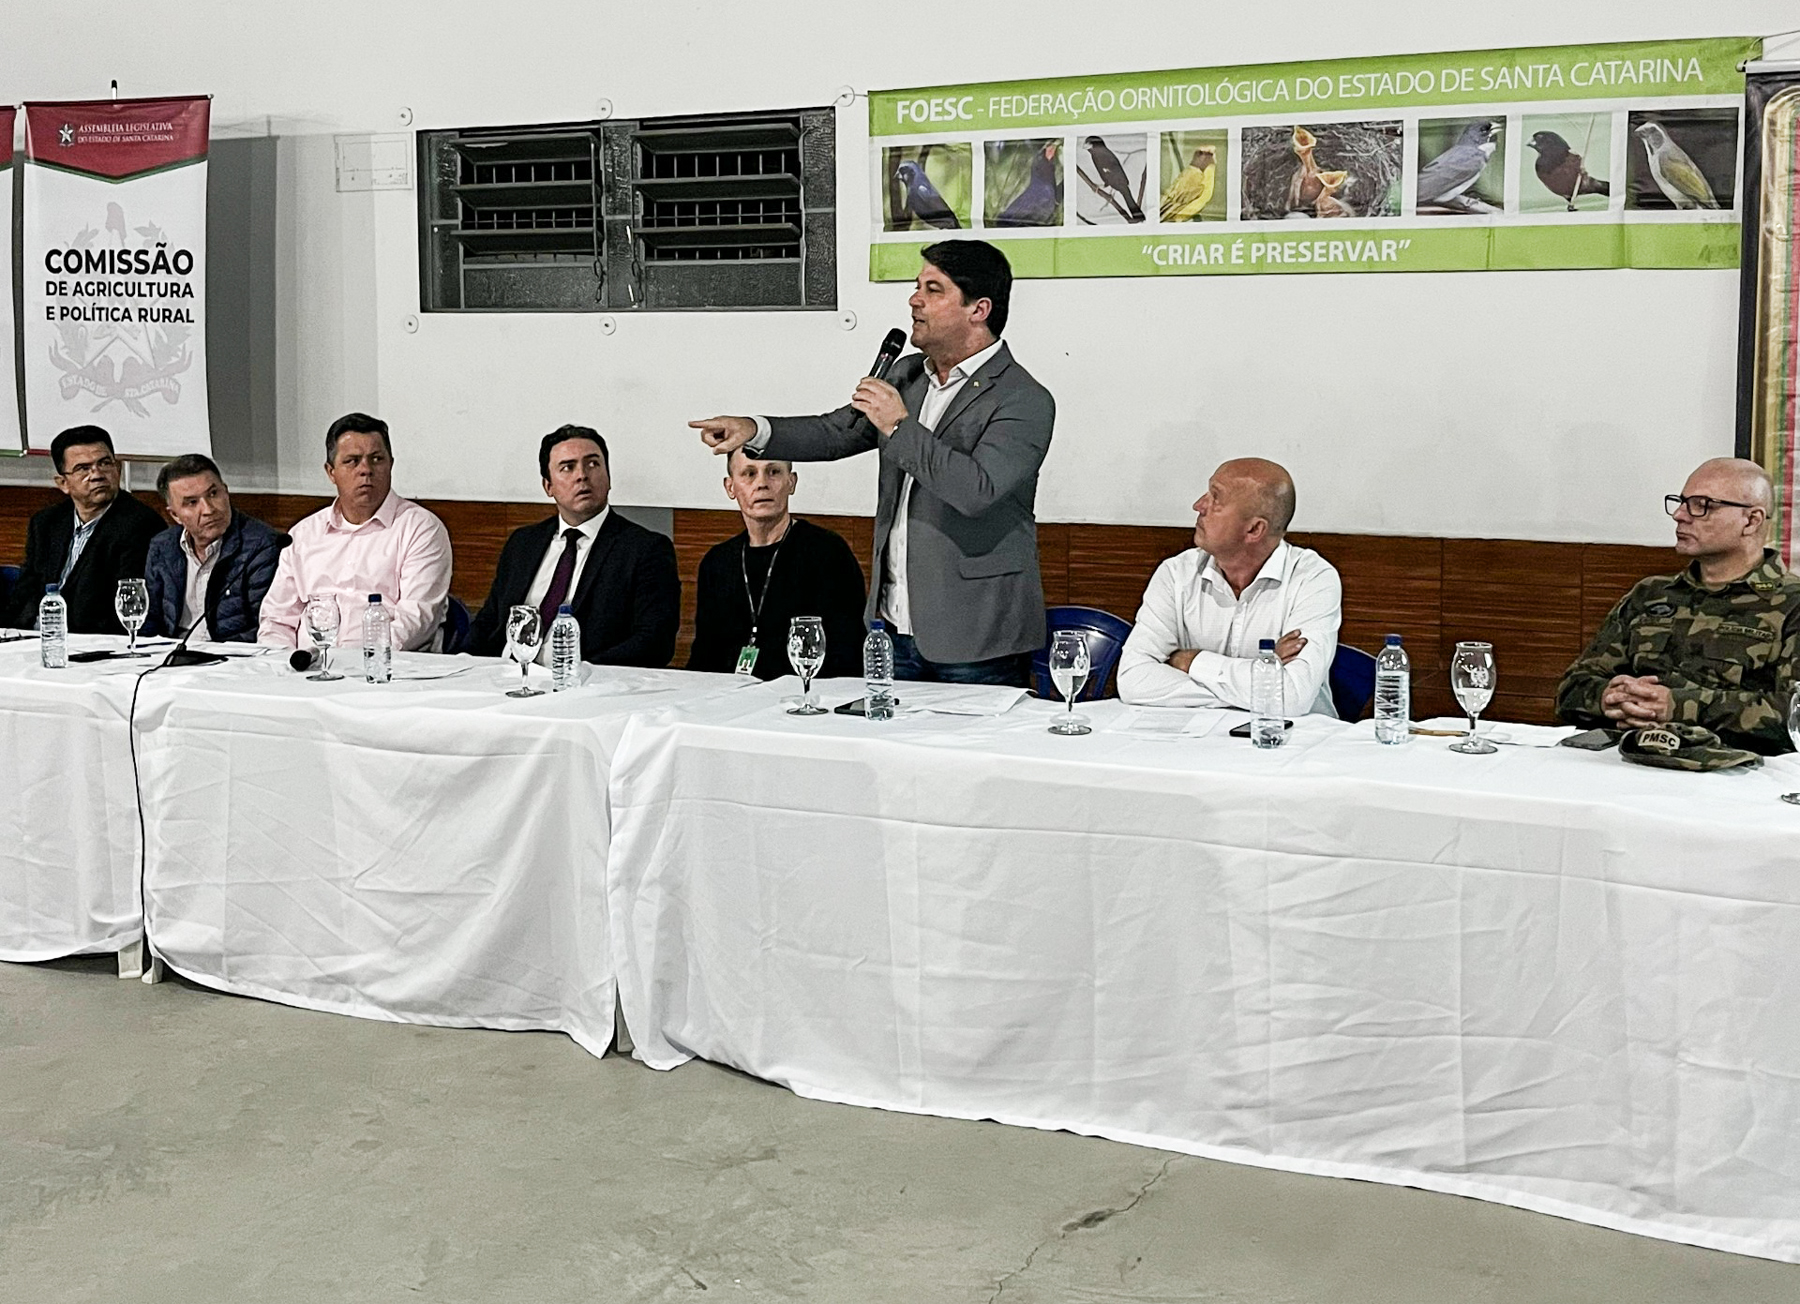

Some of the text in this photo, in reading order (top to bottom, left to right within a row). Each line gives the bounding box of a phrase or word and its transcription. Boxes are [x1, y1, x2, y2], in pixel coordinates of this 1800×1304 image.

[897, 96, 974, 124] FOESC
[988, 87, 1115, 119] FEDERAÇÃO
[1119, 77, 1290, 111] ORNITOLÓGICA
[1295, 76, 1334, 101] DO
[1339, 70, 1435, 98] ESTADO
[1440, 68, 1474, 93] DE
[1480, 64, 1565, 91] SANTA
[1570, 57, 1704, 87] CATARINA
[79, 122, 173, 133] ASSEMBLEIA LEGISLATIVA
[121, 134, 142, 142] SANTA
[142, 134, 174, 142] CATARINA
[44, 242, 194, 275] COMISSÃO
[1230, 239, 1244, 264] É
[46, 281, 194, 298] DE AGRICULTURA
[46, 302, 195, 323] E POLÍTICA RURAL
[1642, 732, 1677, 748] PMSC
